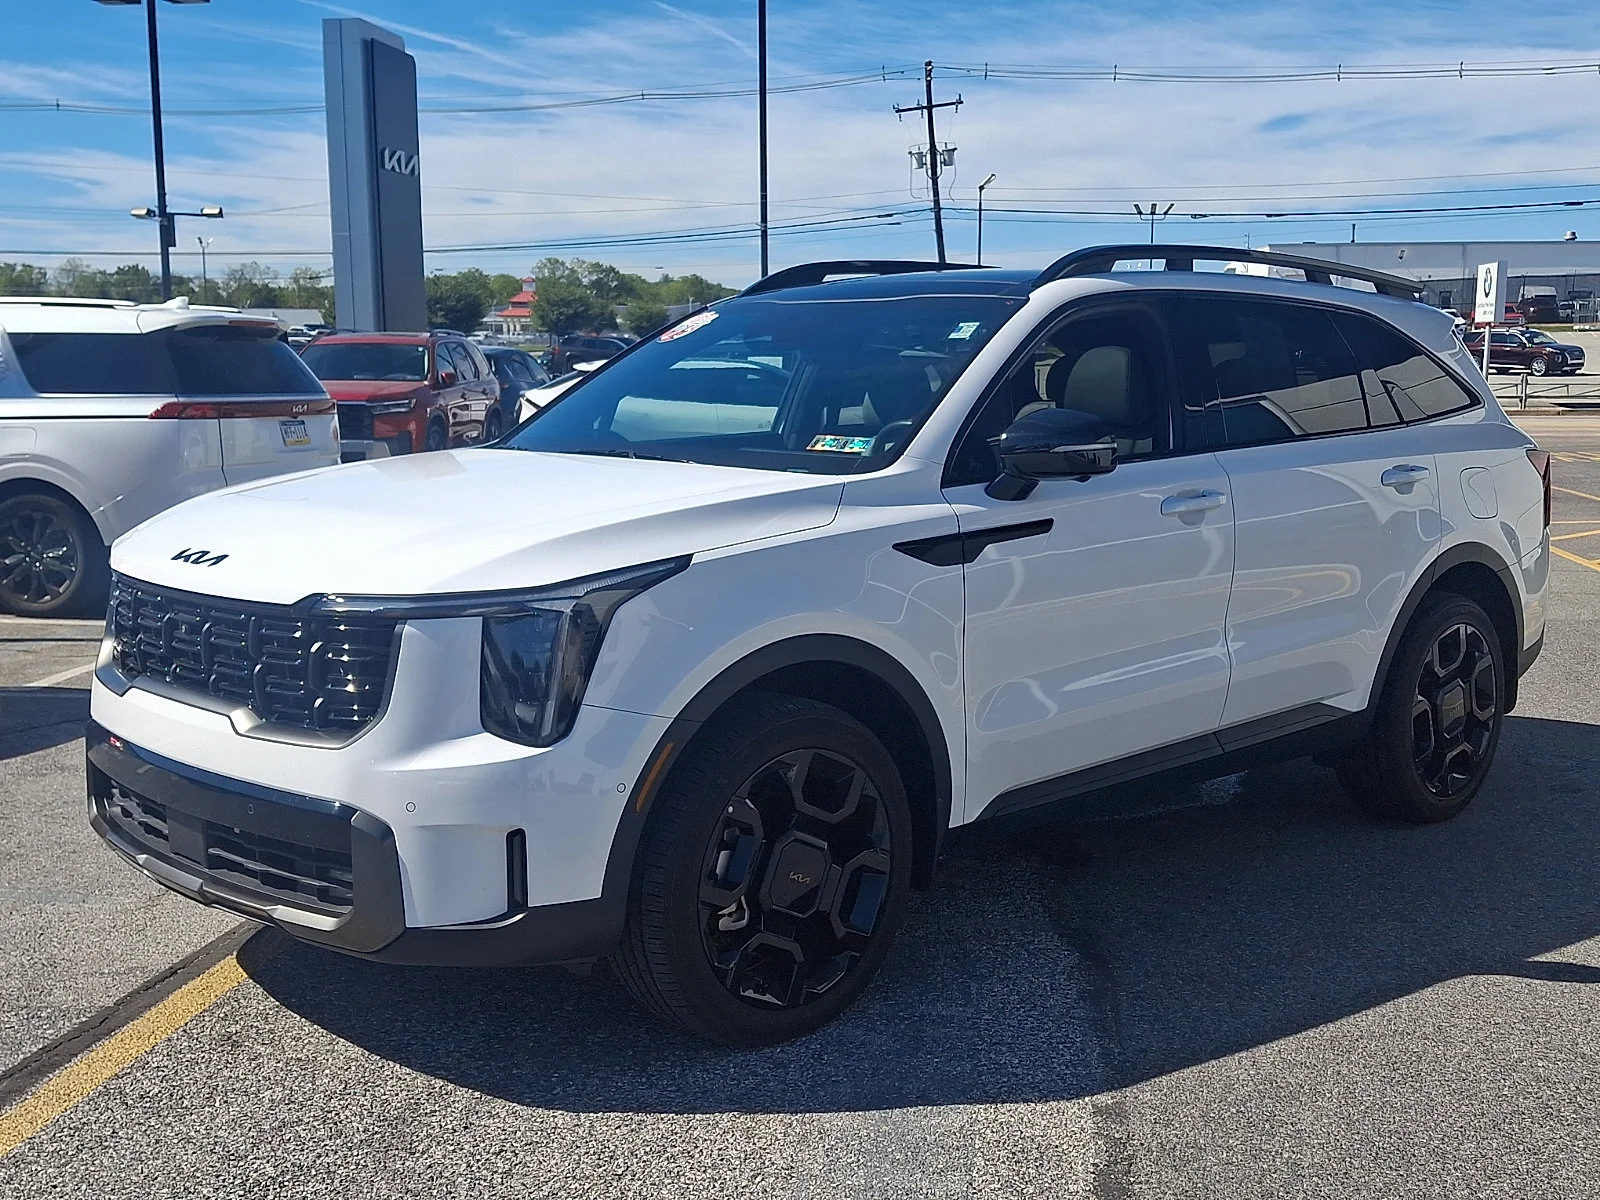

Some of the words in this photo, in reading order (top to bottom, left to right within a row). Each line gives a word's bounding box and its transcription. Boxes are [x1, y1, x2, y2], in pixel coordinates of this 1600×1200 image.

[384, 147, 419, 176] KIA
[292, 404, 308, 413] KIA
[170, 547, 230, 568] KIA
[789, 871, 810, 884] KIA
